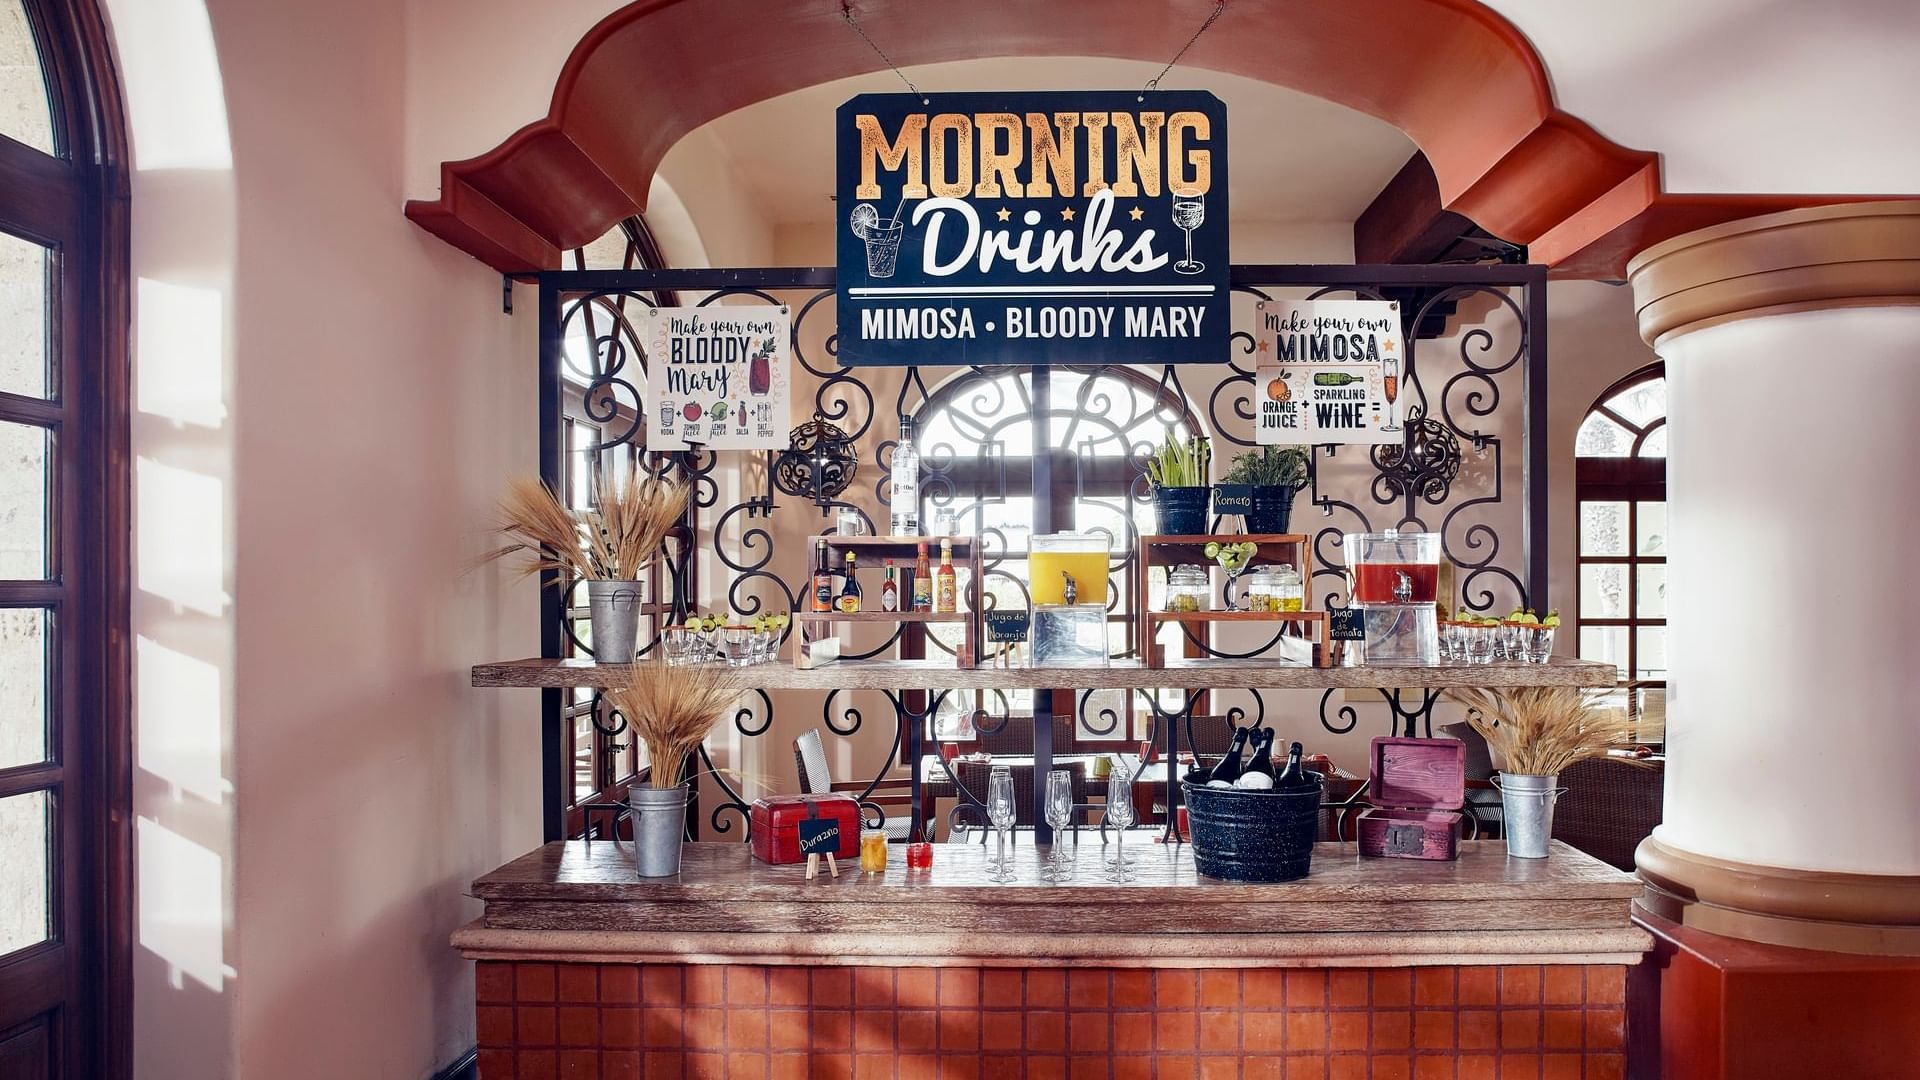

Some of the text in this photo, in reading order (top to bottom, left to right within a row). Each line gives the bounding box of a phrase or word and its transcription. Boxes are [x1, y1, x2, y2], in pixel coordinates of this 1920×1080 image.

[856, 111, 1211, 199] MORNING
[912, 188, 1169, 276] Drinks
[671, 315, 775, 338] Make your own
[861, 306, 1206, 340] MIMOSA BLOODY MARY
[1265, 310, 1392, 338] Make your own
[671, 336, 751, 364] BLOODY
[1277, 334, 1381, 362] MIMOSA
[667, 365, 731, 399] Mary
[1314, 389, 1366, 400] SPARKLING
[1262, 401, 1298, 413] ORANGE
[1262, 414, 1298, 429] JUICE
[1214, 488, 1251, 507] Romero
[989, 611, 1025, 624] Jugo de
[1332, 610, 1353, 622] Jugo
[1337, 621, 1347, 630] de
[988, 625, 1026, 641] Naranja
[800, 827, 839, 851] Durazno
